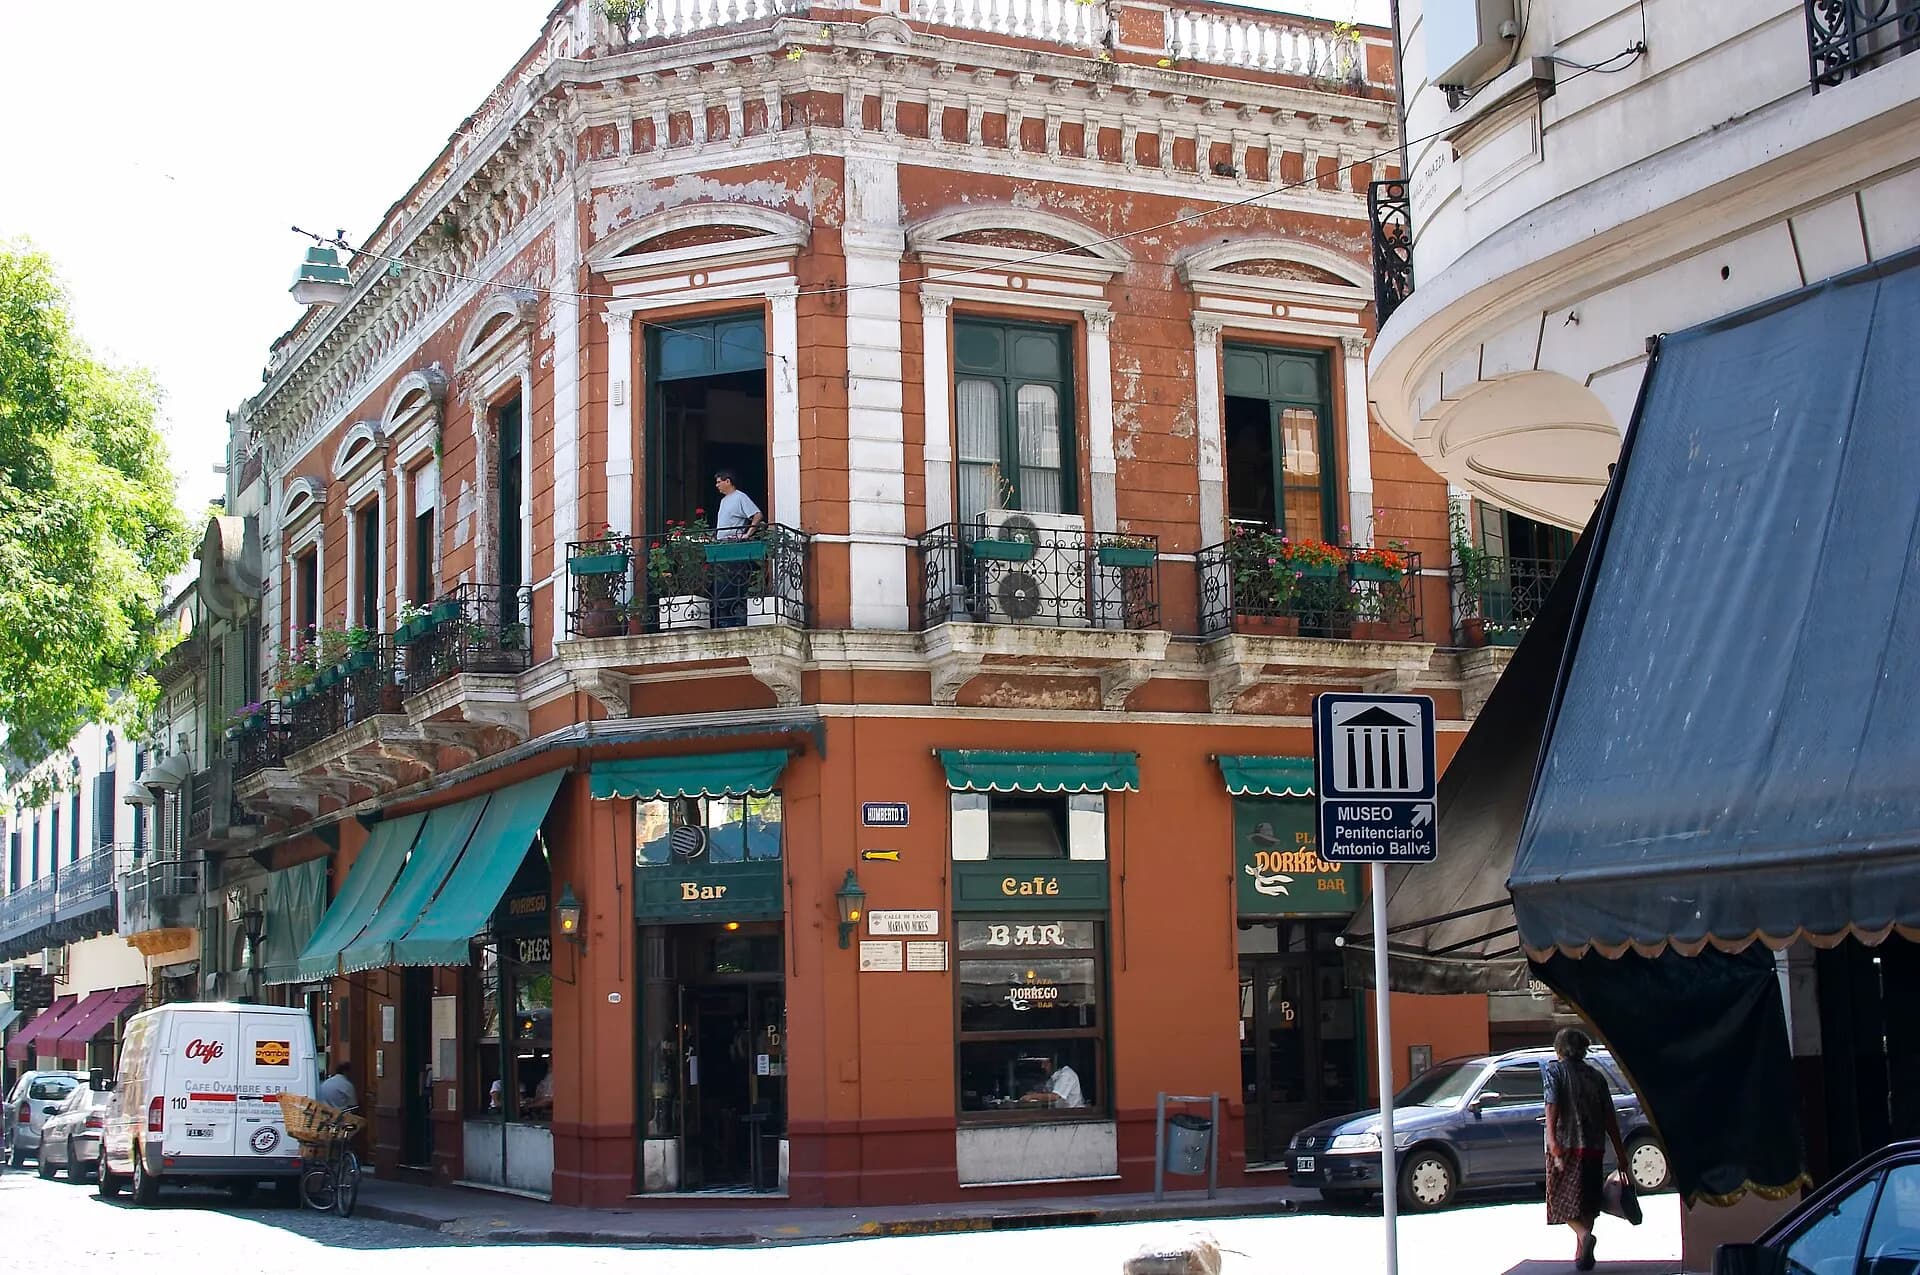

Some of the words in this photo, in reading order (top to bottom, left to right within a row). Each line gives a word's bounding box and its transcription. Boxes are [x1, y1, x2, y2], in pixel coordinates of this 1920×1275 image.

[867, 807, 899, 821] HUMBERTO
[1338, 806, 1393, 821] MUSEO
[1335, 825, 1424, 840] Penitenciario
[1331, 841, 1385, 856] Antonio
[1389, 840, 1431, 855] Ballvé
[680, 882, 727, 900] Bar
[1001, 877, 1060, 896] Café
[1317, 878, 1347, 894] BAR
[986, 924, 1065, 946] BAR
[520, 938, 551, 962] CAFE
[1009, 986, 1058, 1000] DORREGO
[184, 1079, 211, 1092] CAFE
[213, 1080, 261, 1094] OYAMBRE
[170, 1096, 188, 1110] 110
